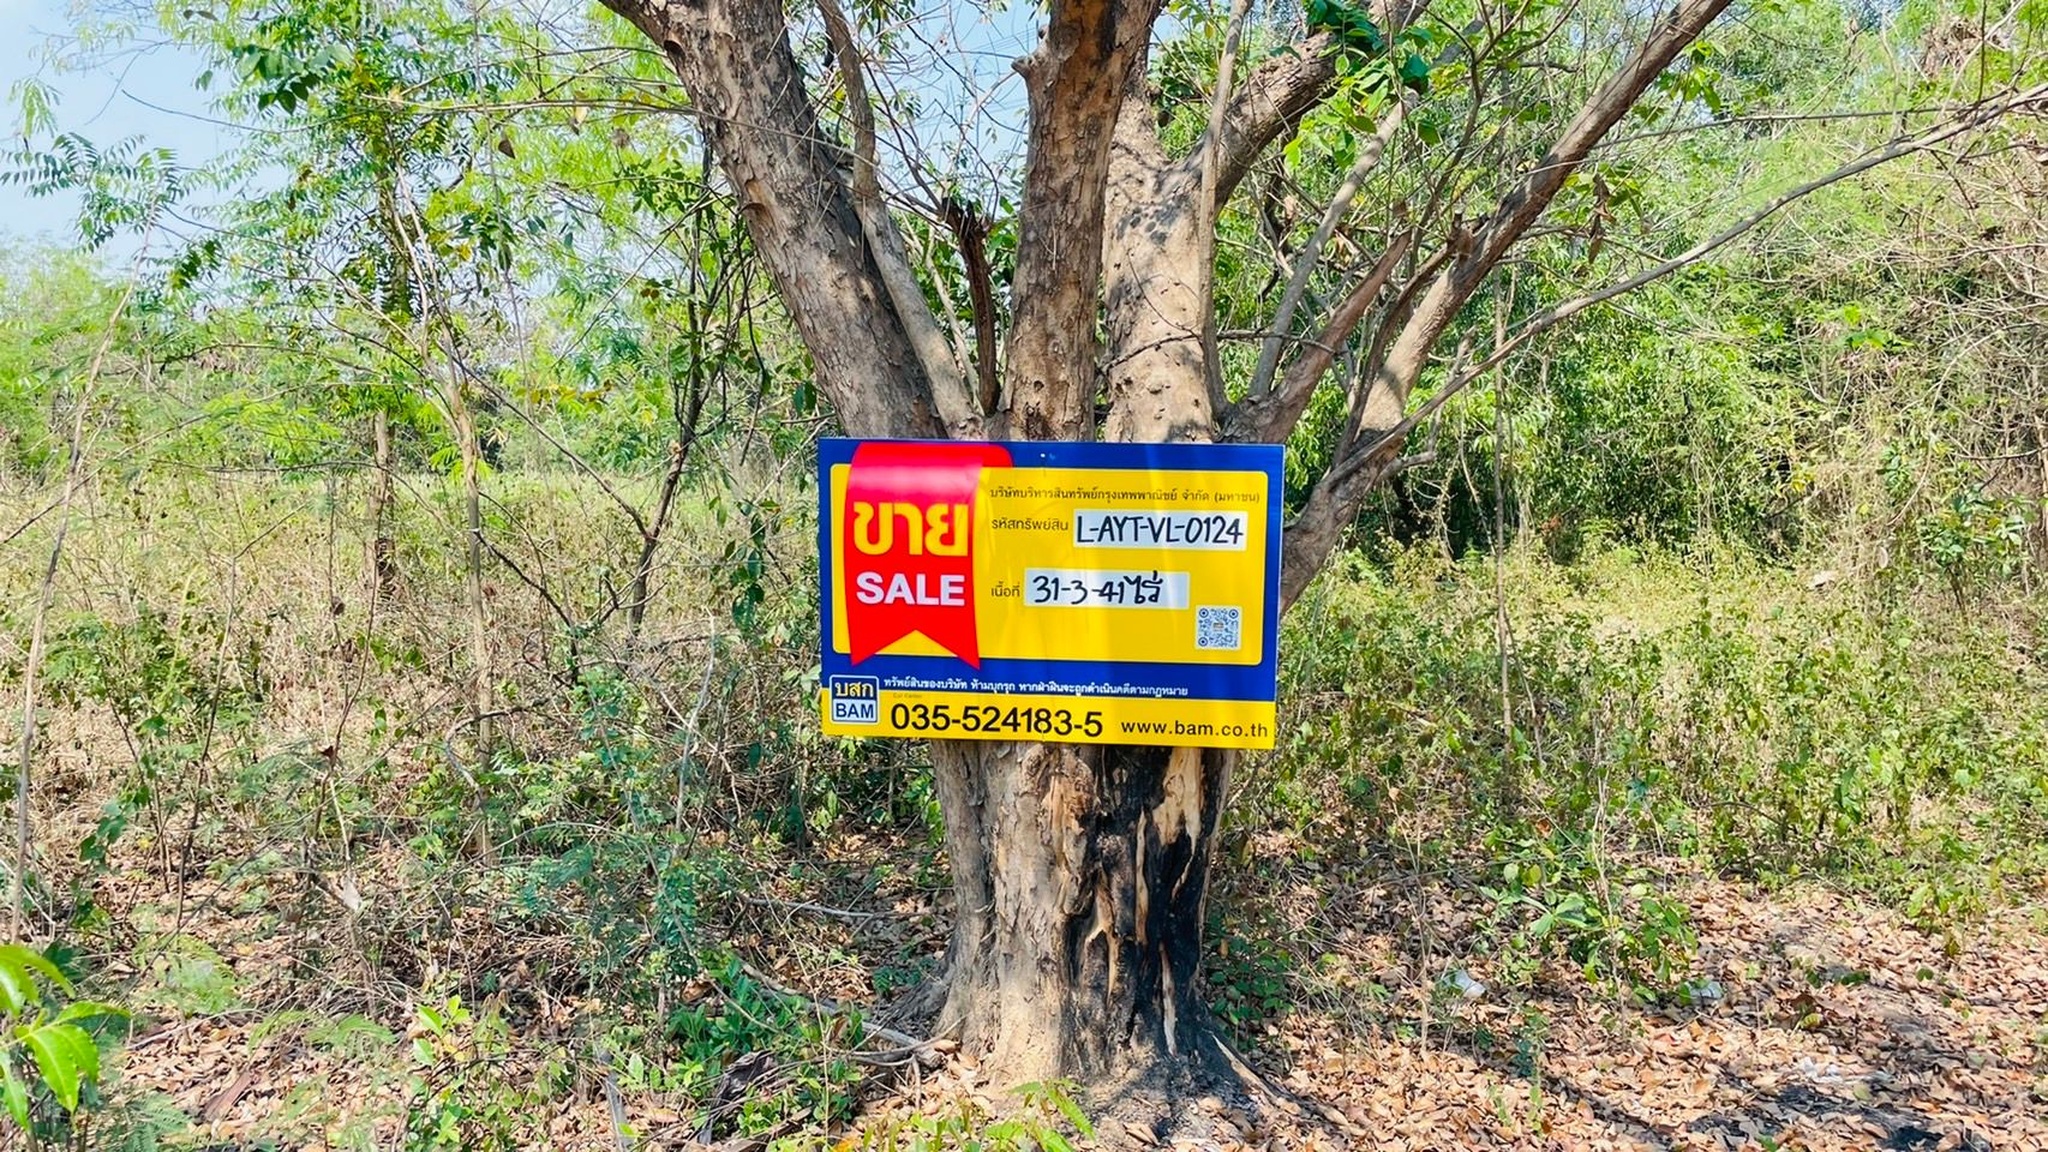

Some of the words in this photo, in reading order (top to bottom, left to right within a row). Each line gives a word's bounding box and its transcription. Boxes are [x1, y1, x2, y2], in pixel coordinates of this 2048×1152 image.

[990, 486, 1178, 504] บริษัทบริหารสินทรัพย์กรุงเทพพาณิชย์
[1181, 488, 1210, 501] จำกัด
[1214, 490, 1261, 503] (มหาชน)
[852, 502, 969, 556] ขาย
[991, 517, 1069, 531] รหัสทรัพย์สิน
[1076, 515, 1244, 545] L-AYT-VL-0124
[856, 572, 966, 607] SALE
[991, 580, 1021, 597] เนื้อที่
[834, 681, 875, 698] บสก
[883, 676, 968, 690] ทรัพย์สินของบริษัท
[970, 678, 1016, 694] ห้ามบุกรุก
[835, 702, 875, 721] BAM
[890, 703, 1104, 738] 035-524183-5
[1120, 719, 1269, 739] www.bam.co.th
